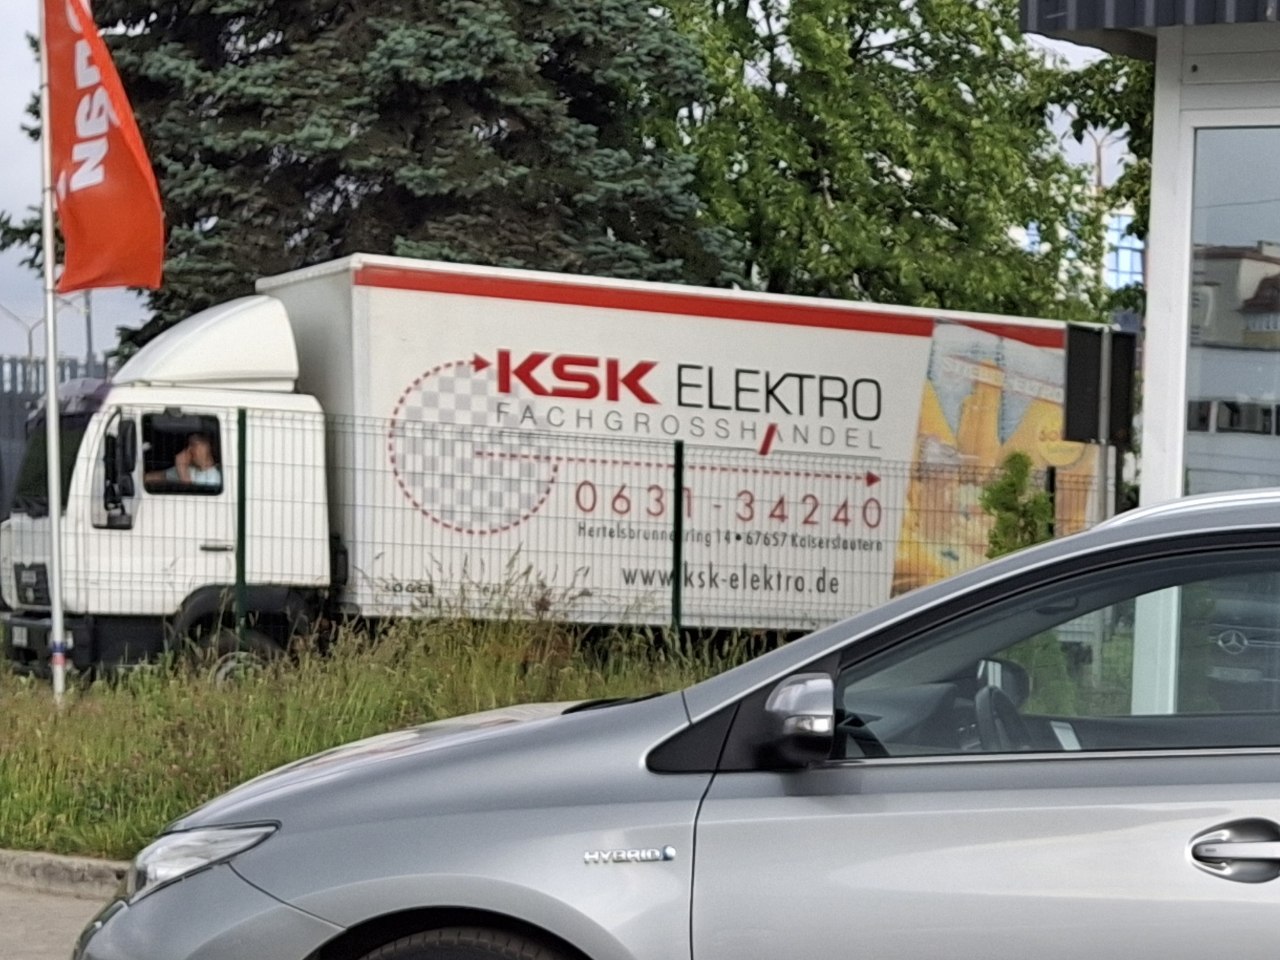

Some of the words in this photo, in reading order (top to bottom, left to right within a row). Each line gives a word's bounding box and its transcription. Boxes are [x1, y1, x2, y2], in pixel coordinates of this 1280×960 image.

[497, 348, 662, 405] KSK
[677, 363, 882, 422] ELEKTRO
[496, 401, 882, 456] FACHGROSSHANDEL
[577, 520, 712, 548] Hertelsbrunnering
[746, 530, 788, 548] 67657
[790, 532, 883, 552] Kaiserslautern
[621, 560, 840, 594] wwwksk-elektro.de
[583, 848, 661, 863] HYBRID
